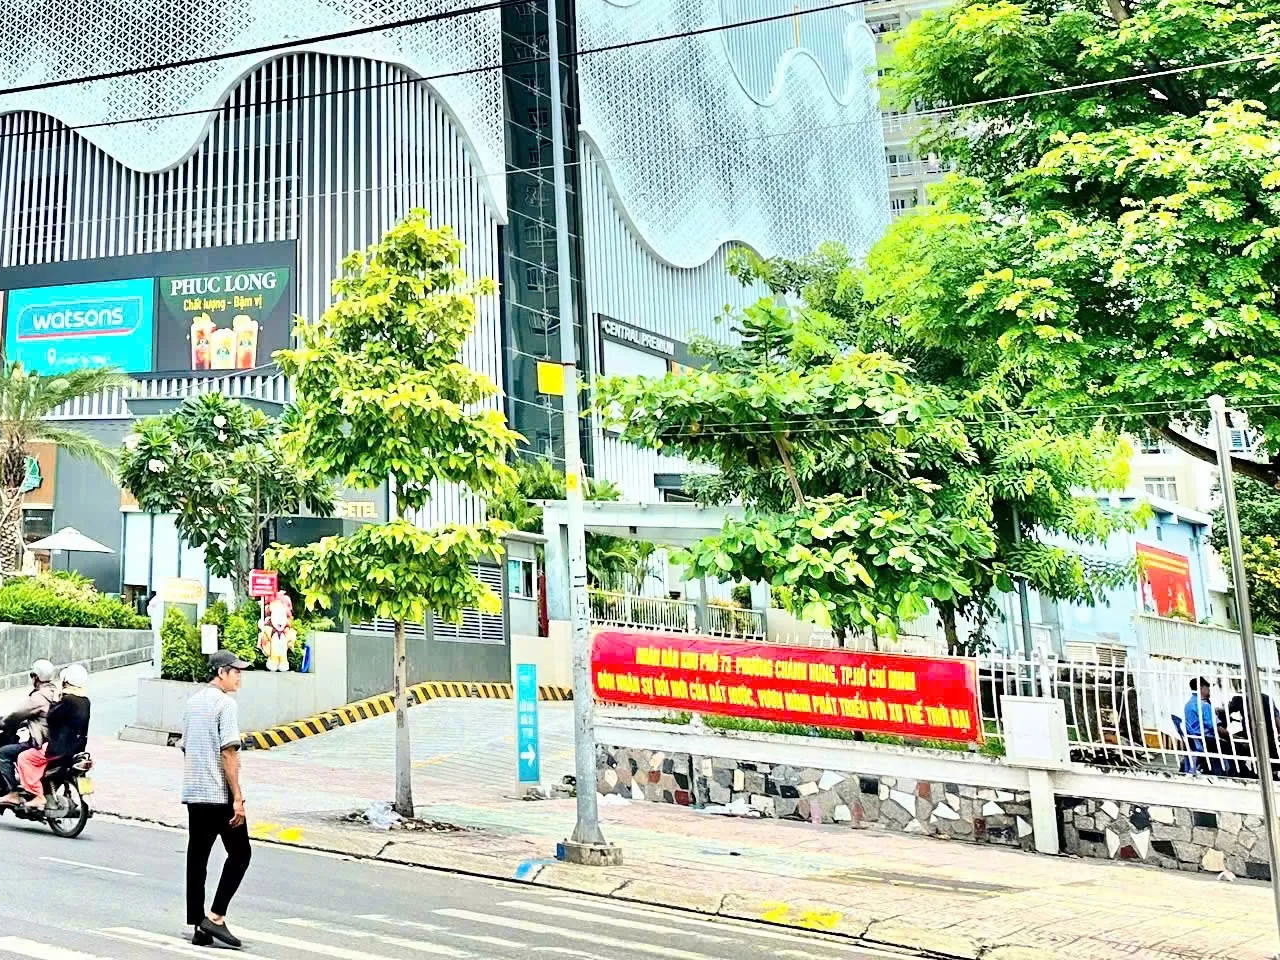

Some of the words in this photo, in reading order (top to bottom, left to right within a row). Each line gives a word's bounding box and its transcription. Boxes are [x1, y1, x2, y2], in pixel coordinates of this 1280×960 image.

[170, 276, 220, 296] PHUC
[224, 272, 277, 292] LONG
[32, 306, 124, 330] watsons
[601, 320, 640, 344] CENTRAL
